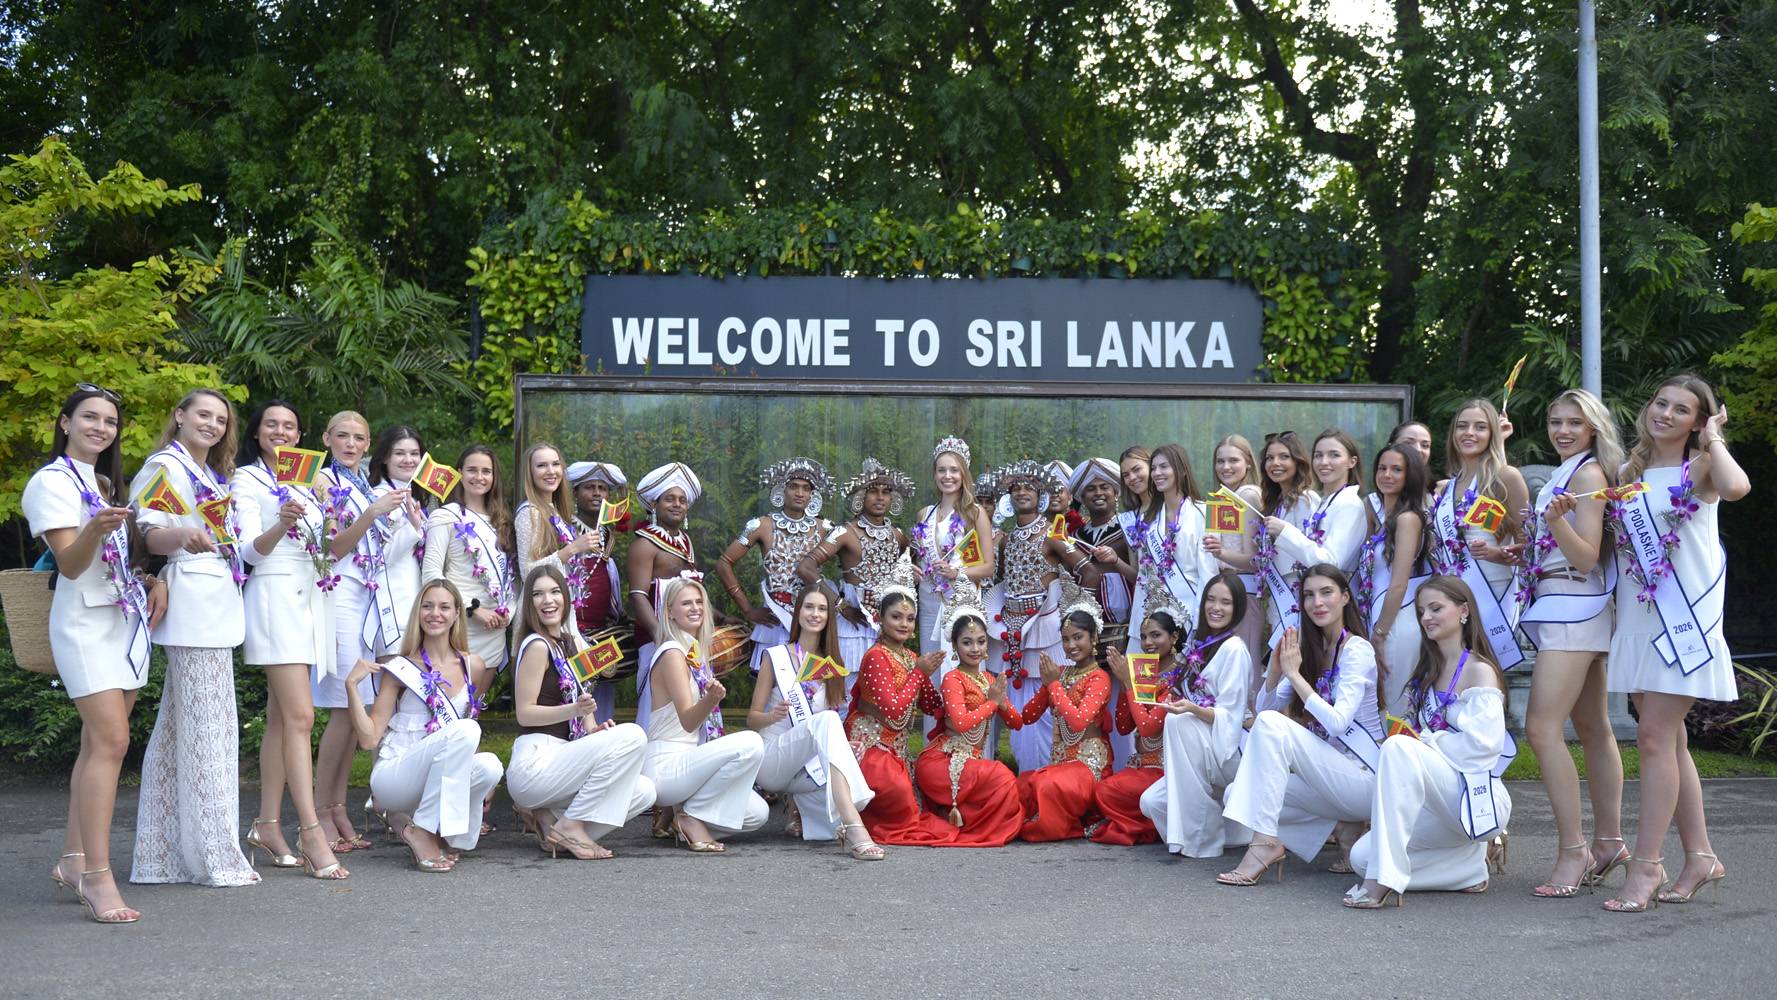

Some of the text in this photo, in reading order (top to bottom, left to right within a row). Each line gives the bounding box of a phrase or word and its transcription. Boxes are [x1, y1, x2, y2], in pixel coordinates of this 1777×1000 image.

[612, 317, 1234, 369] WELCOME TO SRI LANKA
[1628, 507, 1657, 558] PODLASKIE
[1489, 624, 1507, 636] 2026
[1672, 621, 1694, 635] 2026
[1472, 784, 1488, 796] 2026
